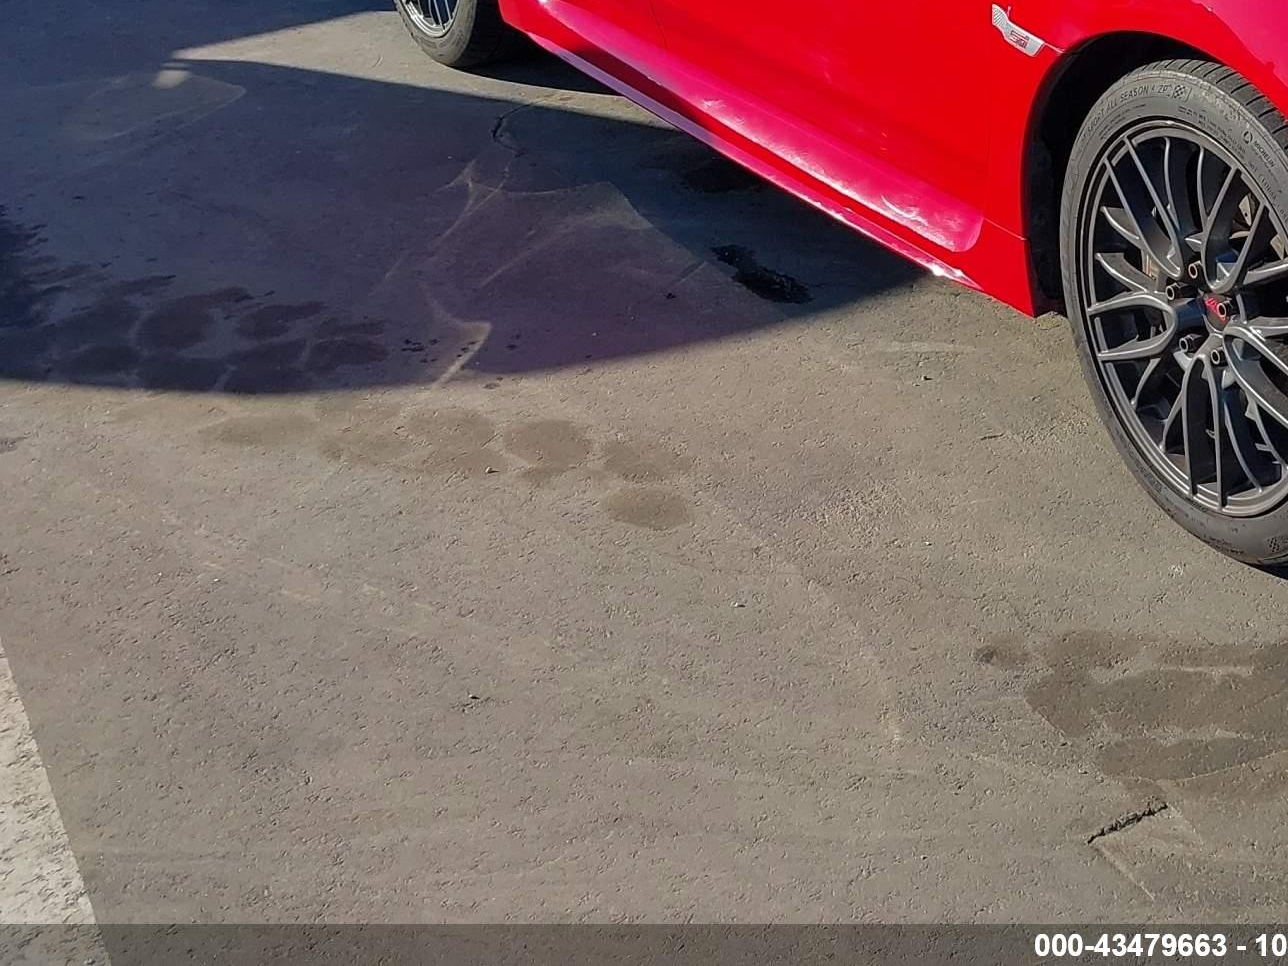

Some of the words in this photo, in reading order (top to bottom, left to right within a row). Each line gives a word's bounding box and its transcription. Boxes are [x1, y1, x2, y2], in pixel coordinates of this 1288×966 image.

[1107, 98, 1118, 112] ALL
[1120, 85, 1149, 103] SEASON
[1253, 140, 1276, 169] MICHELIN
